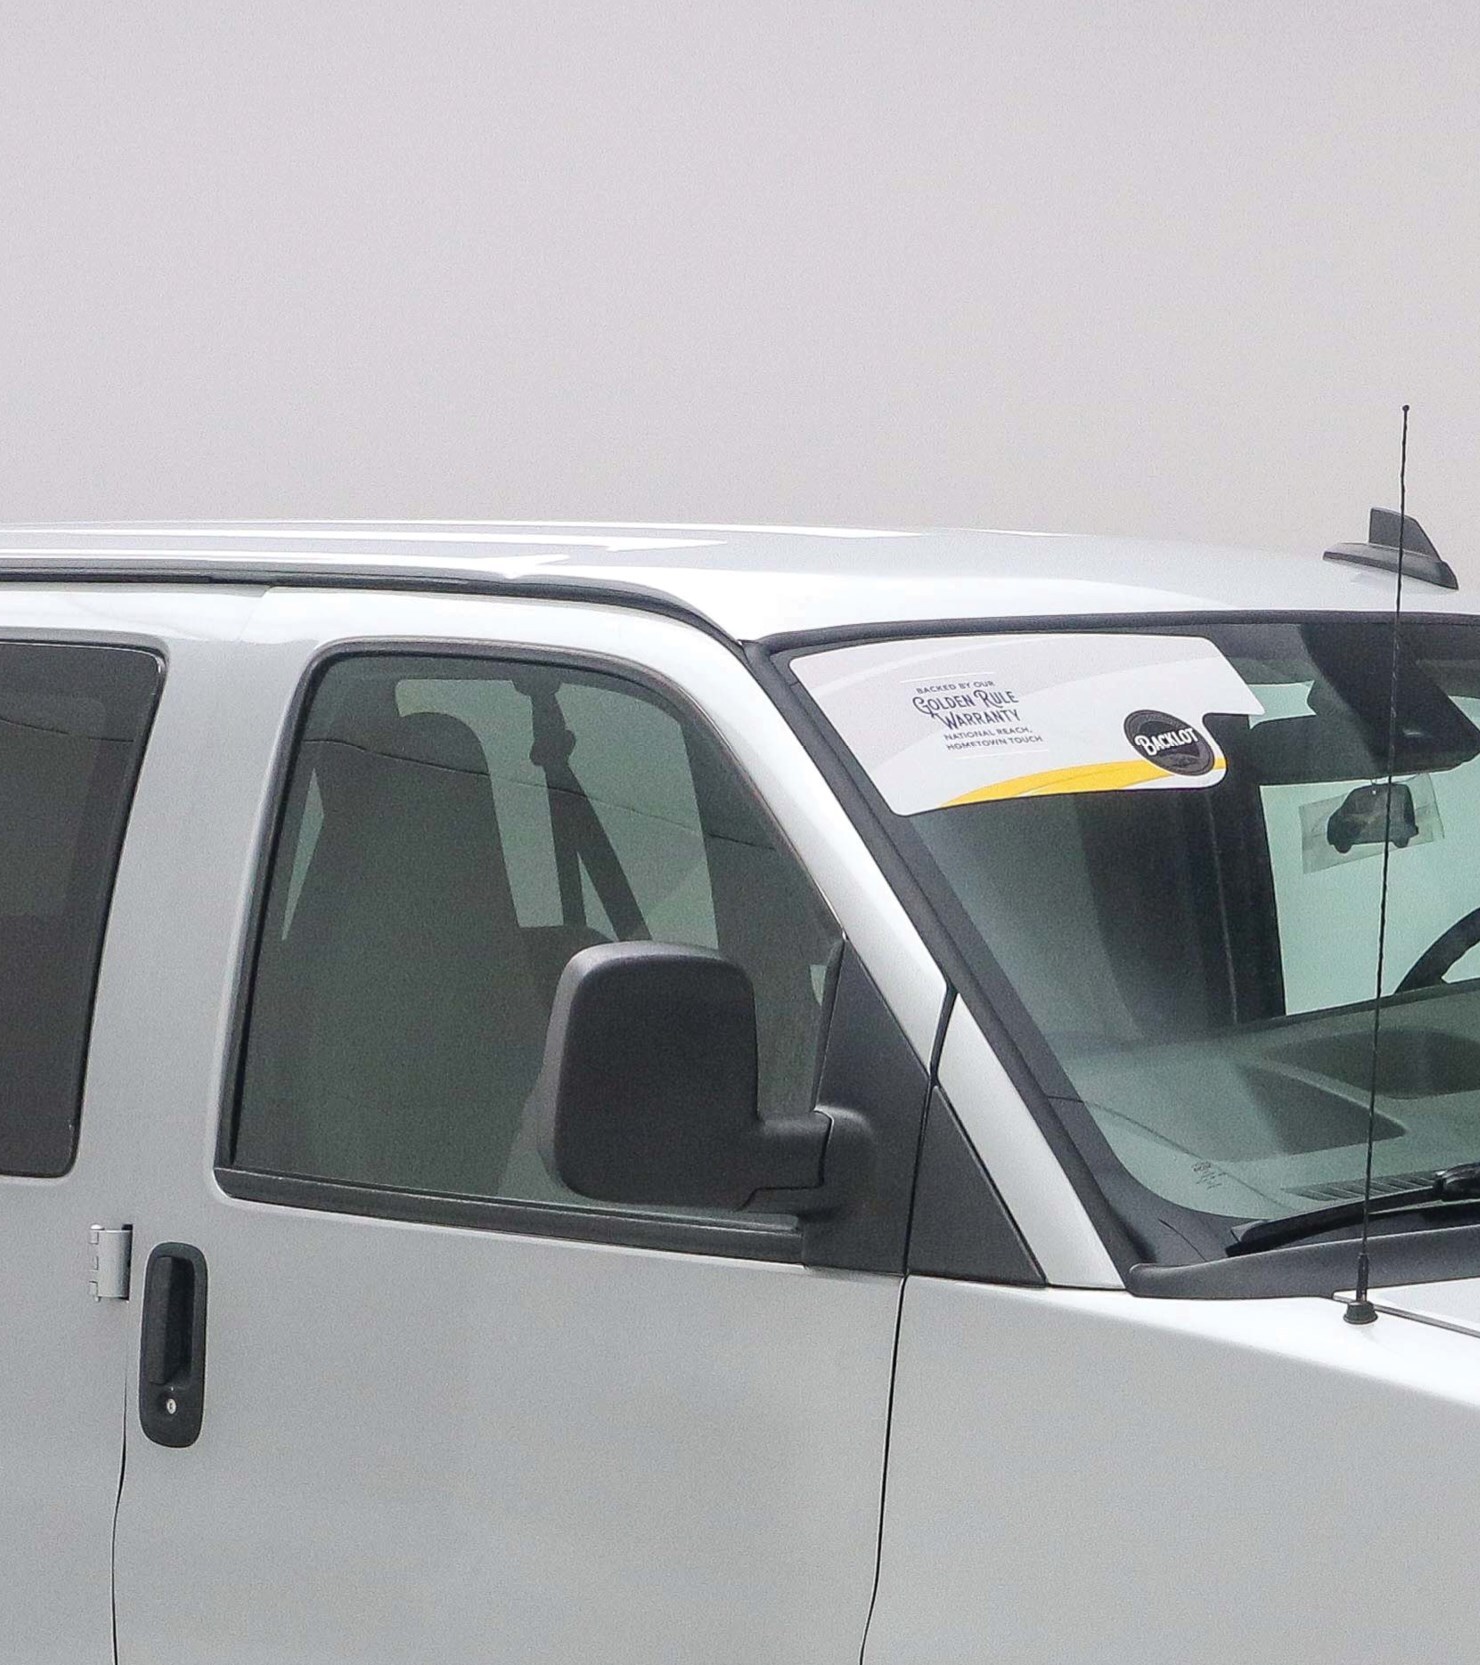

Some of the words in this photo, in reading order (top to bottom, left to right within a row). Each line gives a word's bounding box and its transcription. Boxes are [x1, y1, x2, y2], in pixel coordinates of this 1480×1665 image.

[916, 683, 957, 694] BACKED
[960, 682, 971, 690] BY
[973, 680, 996, 688] OUR
[912, 693, 976, 715] GOLDEN
[973, 689, 1020, 708] RULE
[932, 709, 1021, 730] WARRANTY
[944, 729, 996, 741] NATIONAL
[945, 737, 1007, 751] HOMETOWN
[1009, 735, 1044, 745] TOUCH
[1134, 727, 1199, 756] BACKLOT
